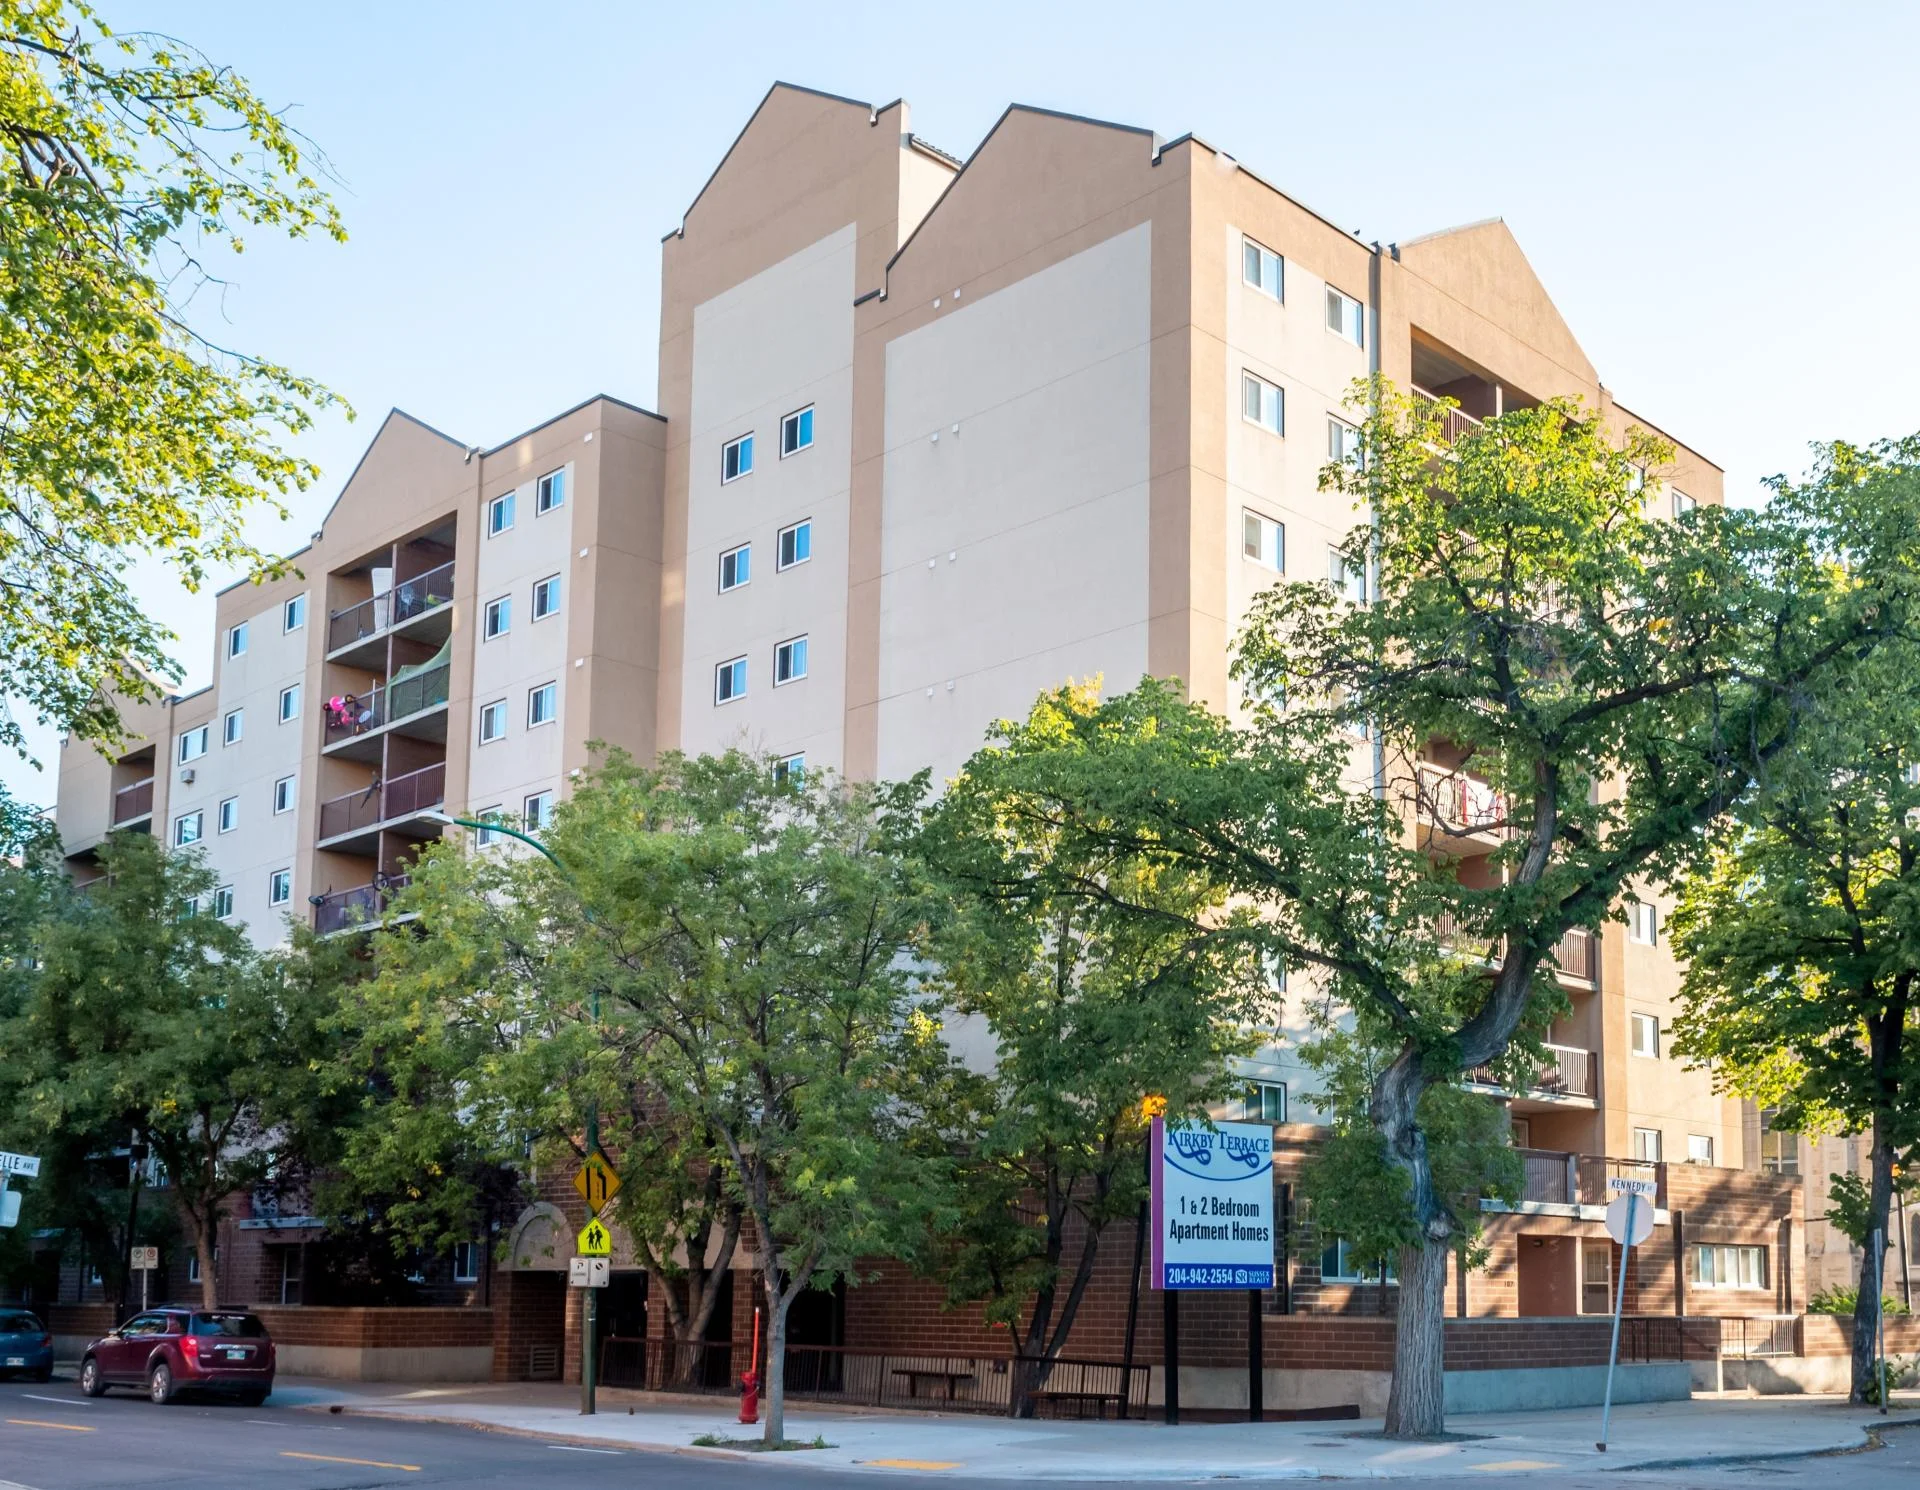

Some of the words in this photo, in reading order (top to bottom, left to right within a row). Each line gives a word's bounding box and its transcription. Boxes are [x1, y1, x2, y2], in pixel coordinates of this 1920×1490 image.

[1168, 1129, 1215, 1163] KIRKBY
[1219, 1131, 1270, 1167] TERRACE
[1611, 1179, 1646, 1193] KENNEDY
[1180, 1195, 1185, 1215] 1
[1190, 1200, 1197, 1215] &
[1201, 1196, 1208, 1215] 2
[1211, 1196, 1260, 1217] Bedroom
[1170, 1219, 1229, 1244] Apartment
[1232, 1221, 1269, 1242] Homes
[1168, 1267, 1233, 1284] 204-942-2554
